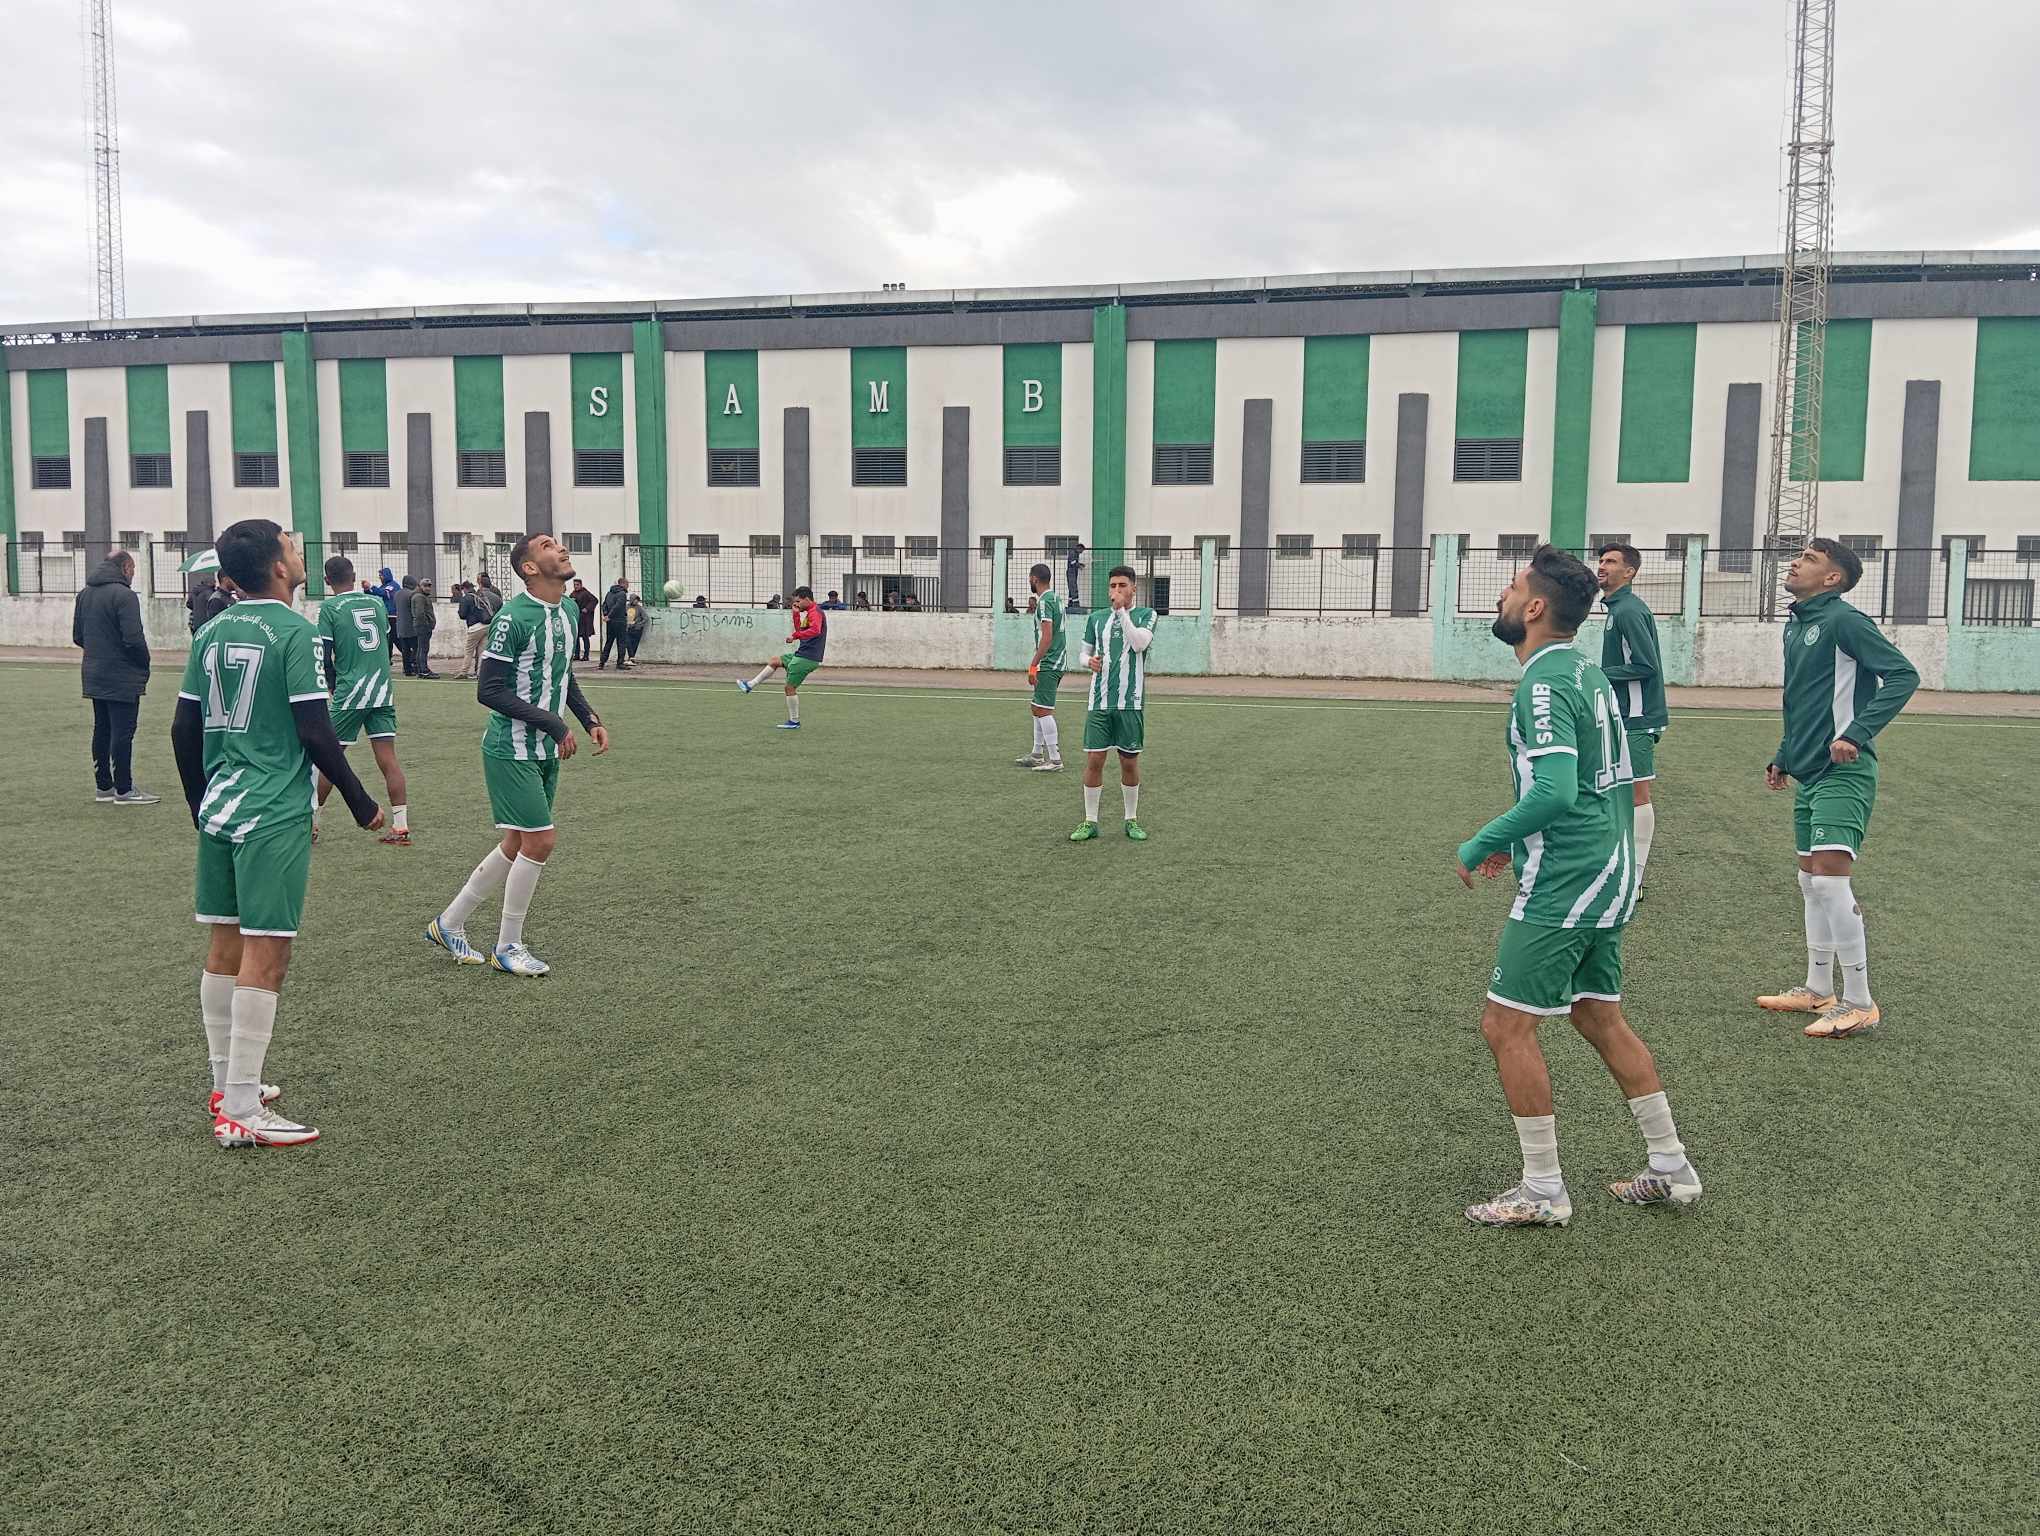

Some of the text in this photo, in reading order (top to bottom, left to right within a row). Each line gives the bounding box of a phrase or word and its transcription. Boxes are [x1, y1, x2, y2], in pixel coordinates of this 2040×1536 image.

[352, 608, 380, 651] 5
[490, 613, 513, 652] 1938
[203, 642, 265, 733] 17
[1532, 683, 1553, 744] SAMB
